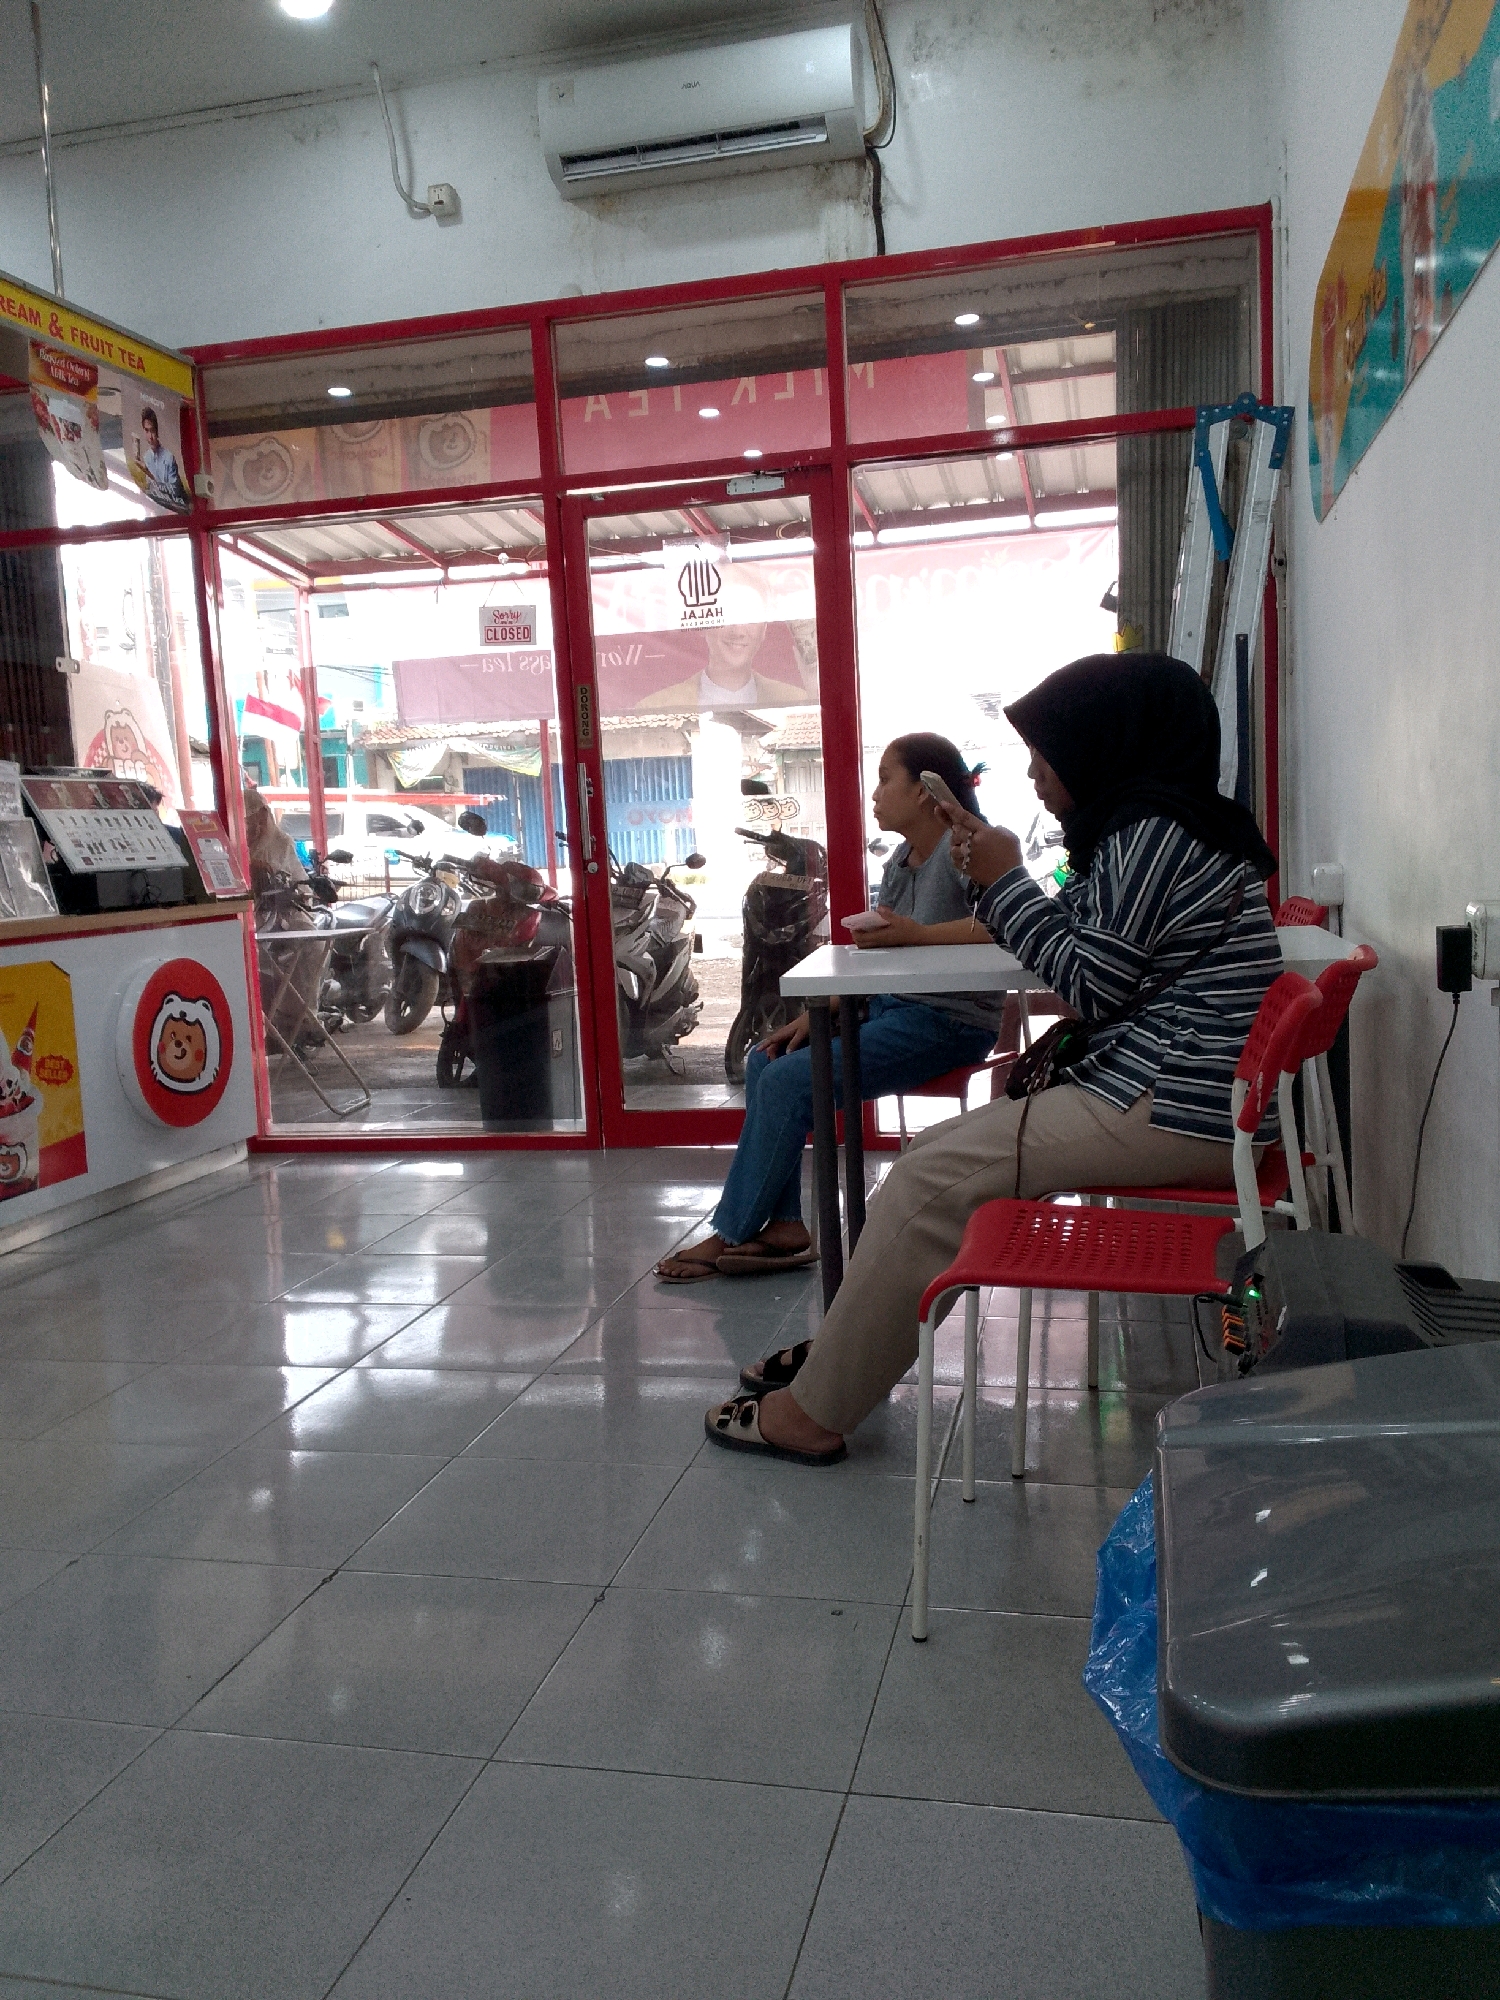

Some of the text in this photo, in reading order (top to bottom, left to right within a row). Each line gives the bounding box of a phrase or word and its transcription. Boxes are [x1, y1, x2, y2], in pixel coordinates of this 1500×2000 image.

[48, 312, 64, 341] &
[70, 326, 114, 359] FRUIT
[118, 346, 146, 374] TEA
[492, 609, 522, 625] Sorry
[486, 626, 530, 641] CLOSED
[579, 686, 590, 737] DORONG
[44, 1058, 65, 1069] BEST
